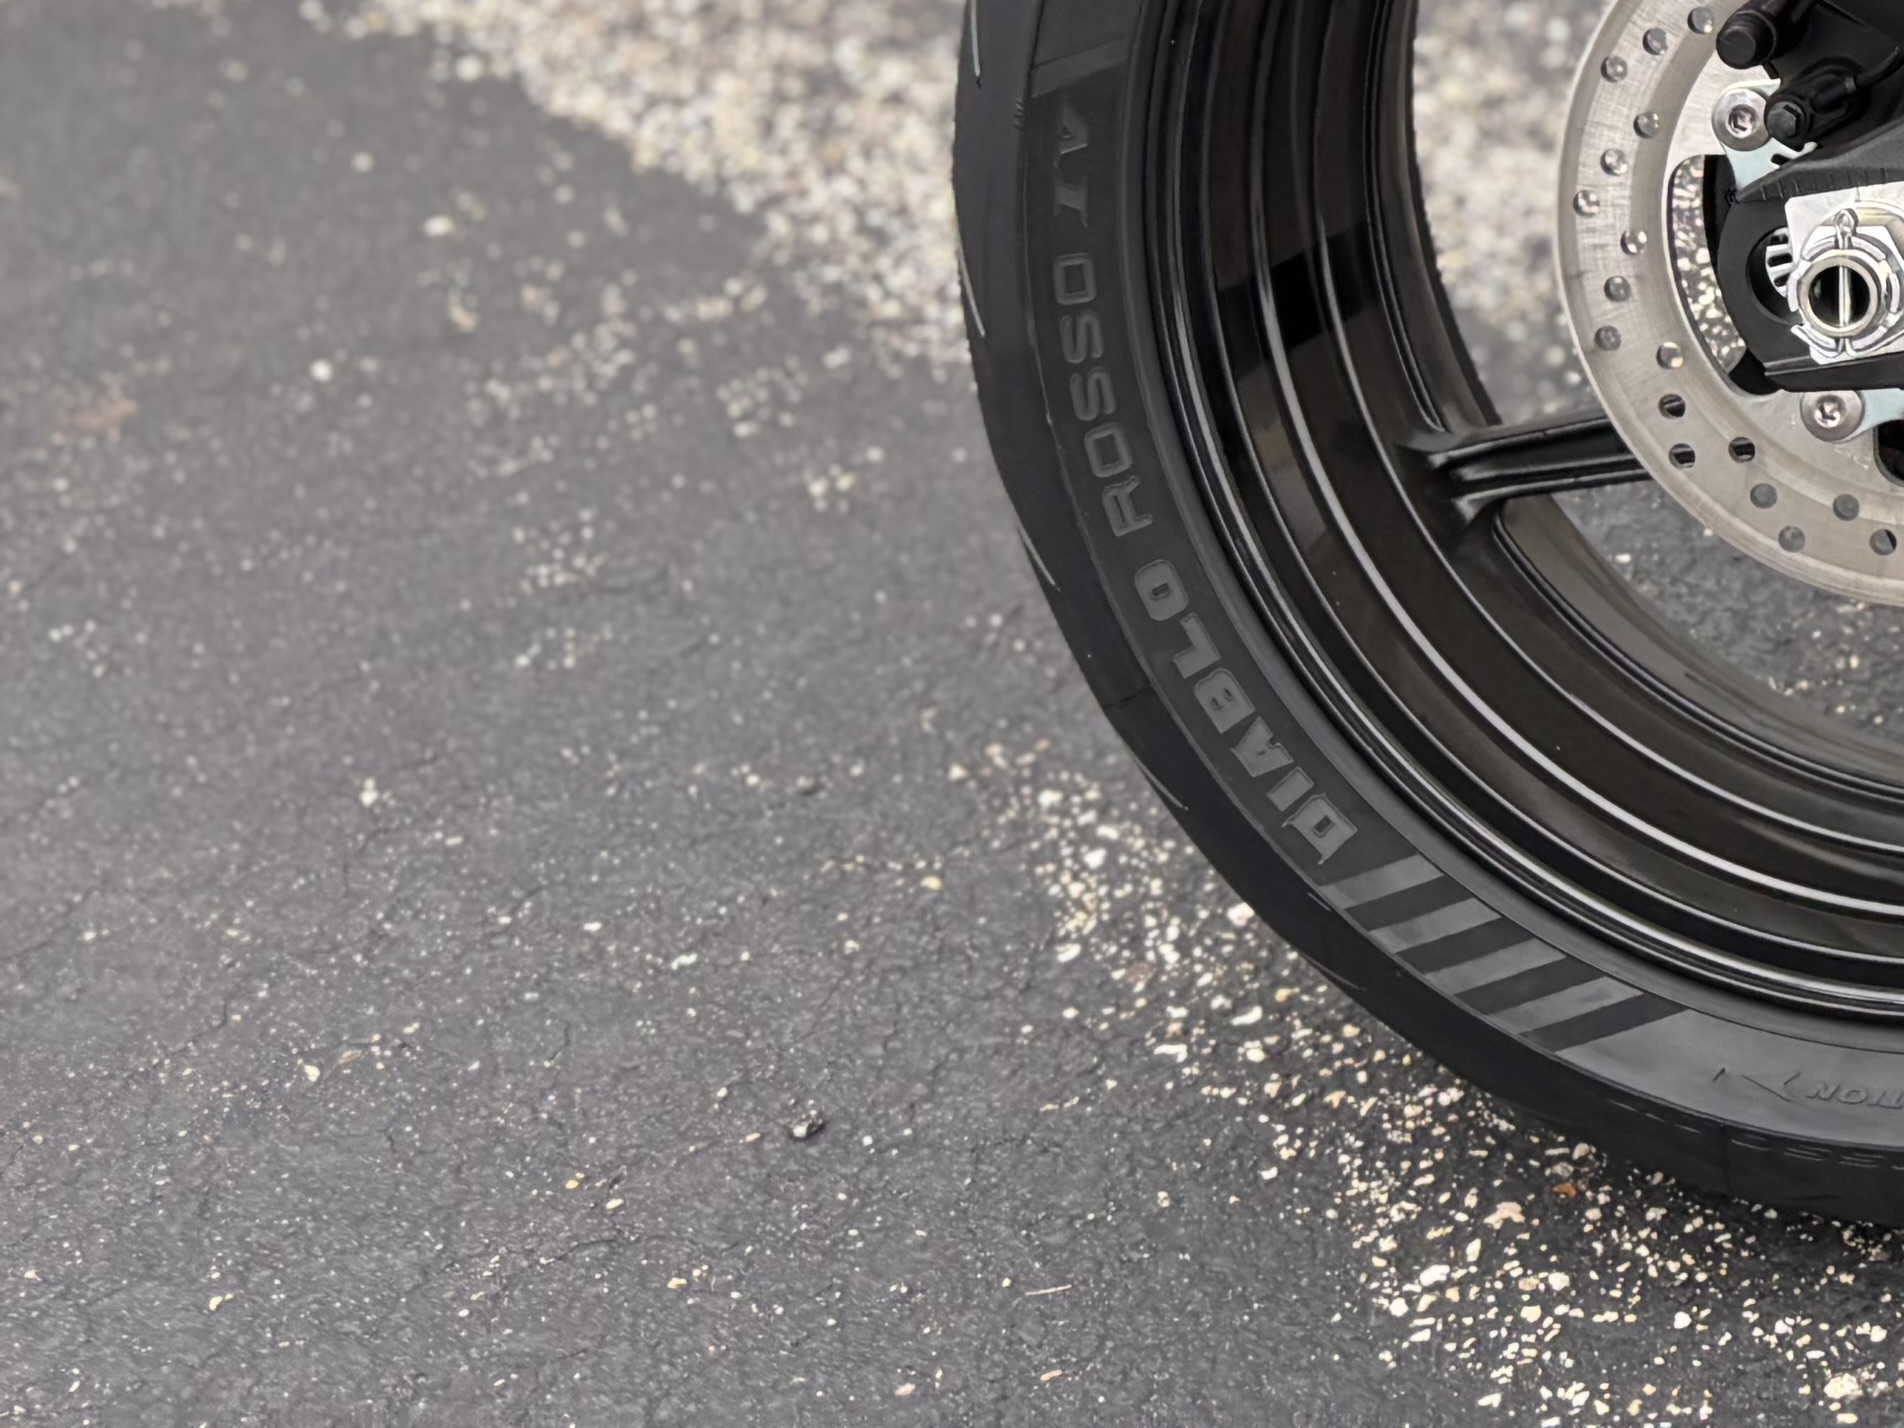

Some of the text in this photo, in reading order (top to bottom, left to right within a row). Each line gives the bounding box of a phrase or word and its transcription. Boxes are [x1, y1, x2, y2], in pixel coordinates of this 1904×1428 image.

[1051, 94, 1359, 865] DIABLO ROSSO IV
